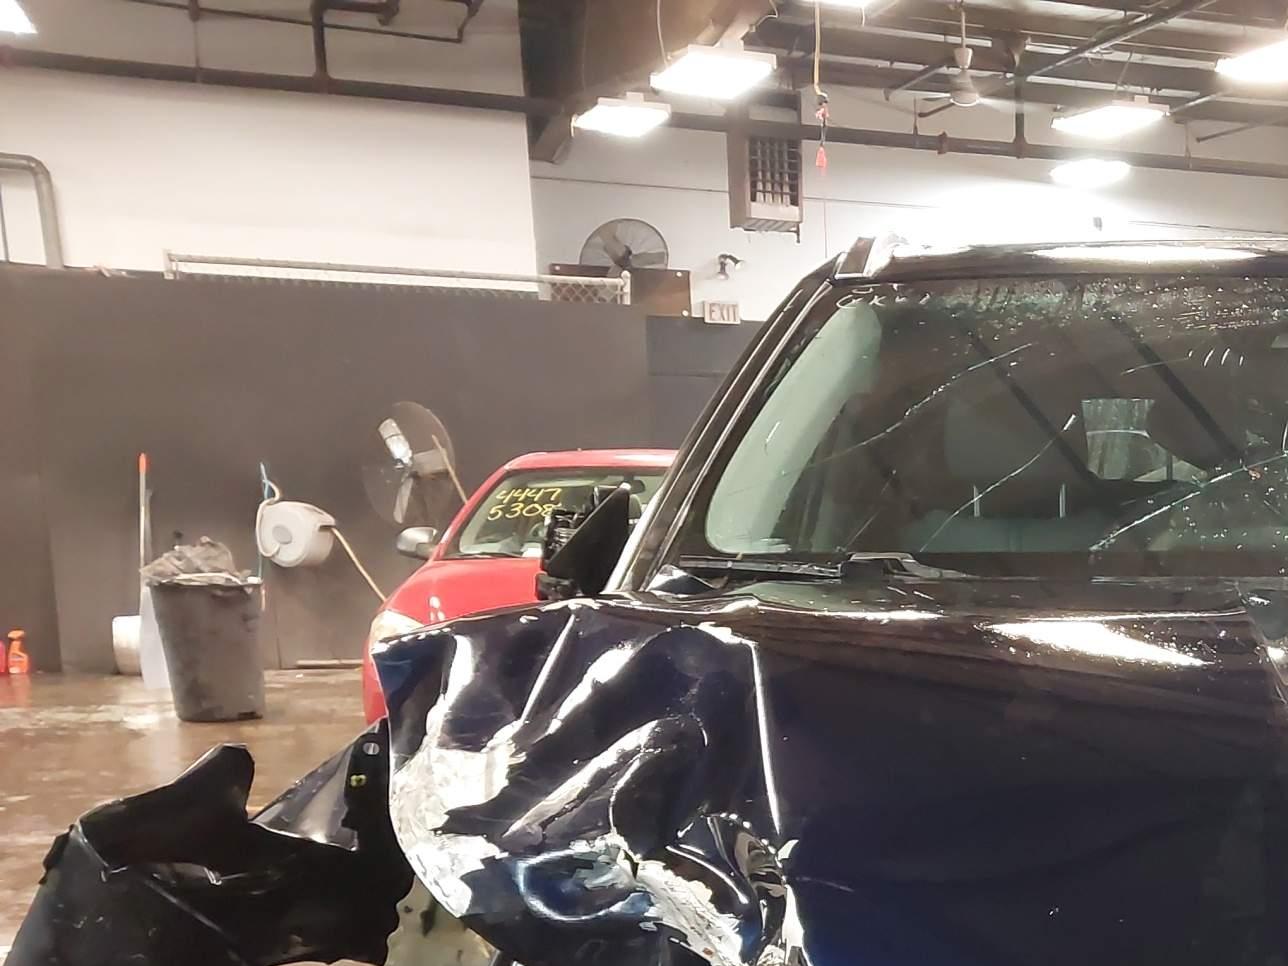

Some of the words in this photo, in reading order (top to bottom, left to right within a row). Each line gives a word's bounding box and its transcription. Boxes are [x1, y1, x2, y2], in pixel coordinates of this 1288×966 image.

[709, 303, 738, 321] EXIT
[495, 488, 562, 503] 4447
[487, 502, 561, 520] 5308
